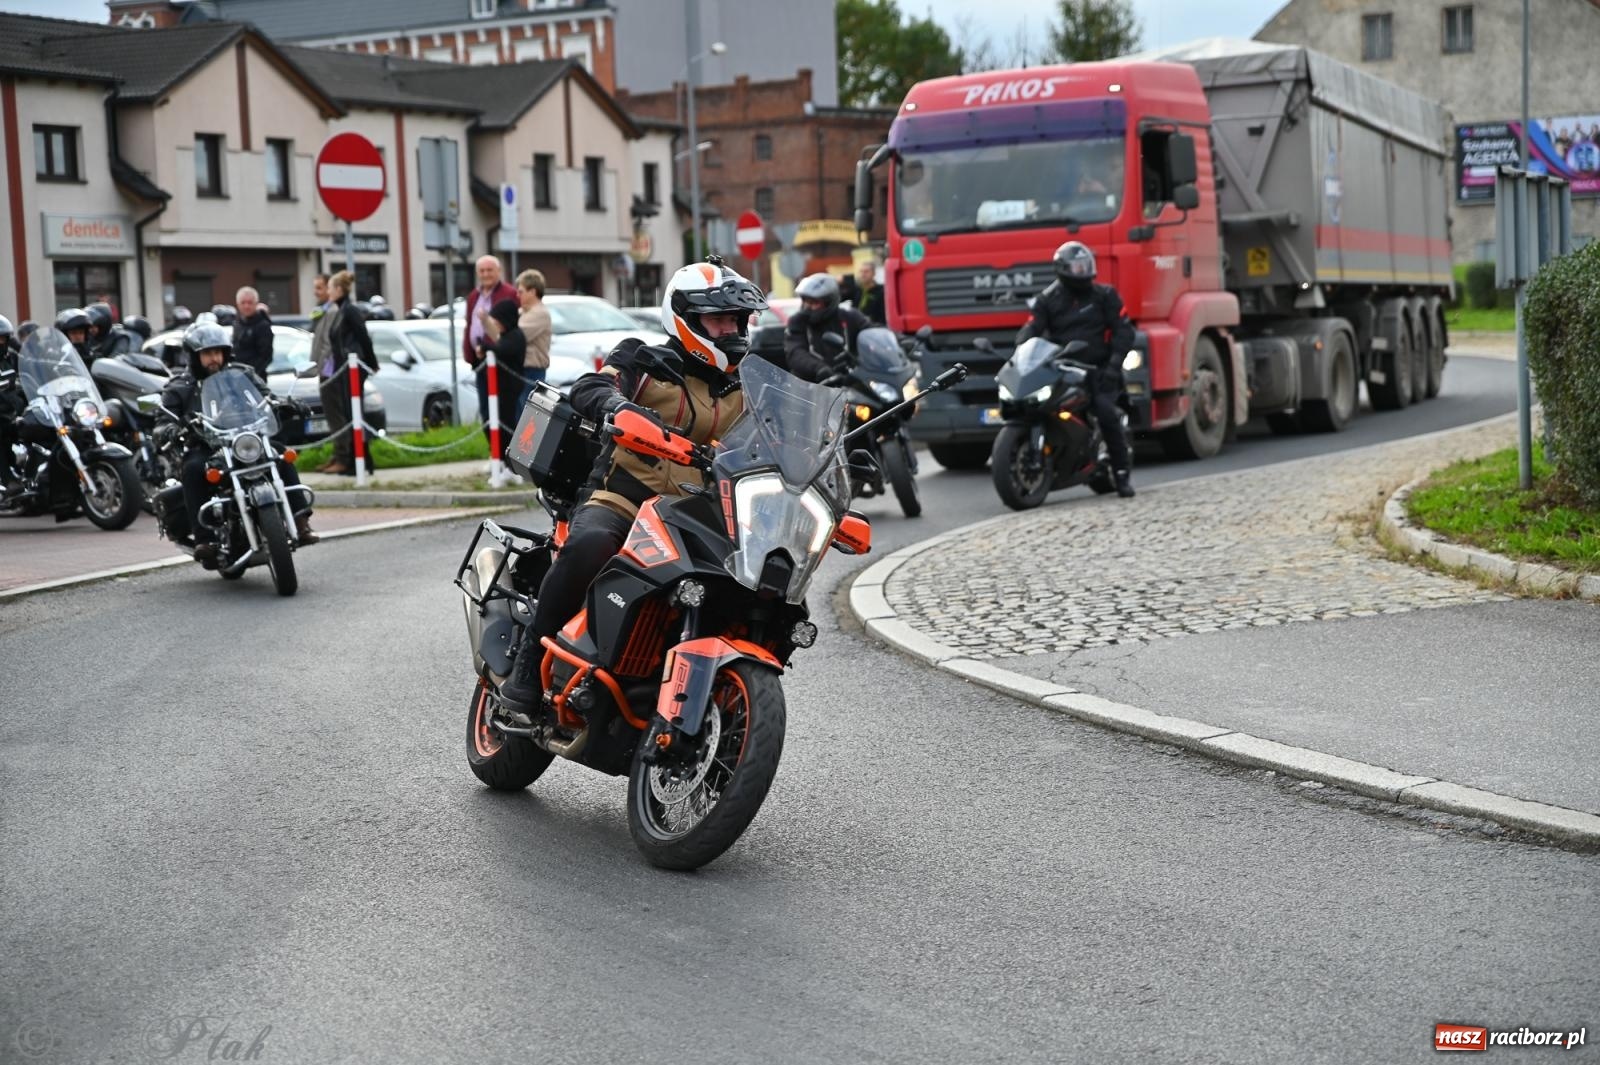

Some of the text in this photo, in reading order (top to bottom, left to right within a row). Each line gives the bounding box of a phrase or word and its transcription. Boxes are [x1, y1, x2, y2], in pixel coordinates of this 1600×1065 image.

[963, 76, 1058, 105] PAKOS
[62, 217, 121, 239] dentica
[973, 272, 1033, 288] MAN
[606, 592, 626, 608] KTM
